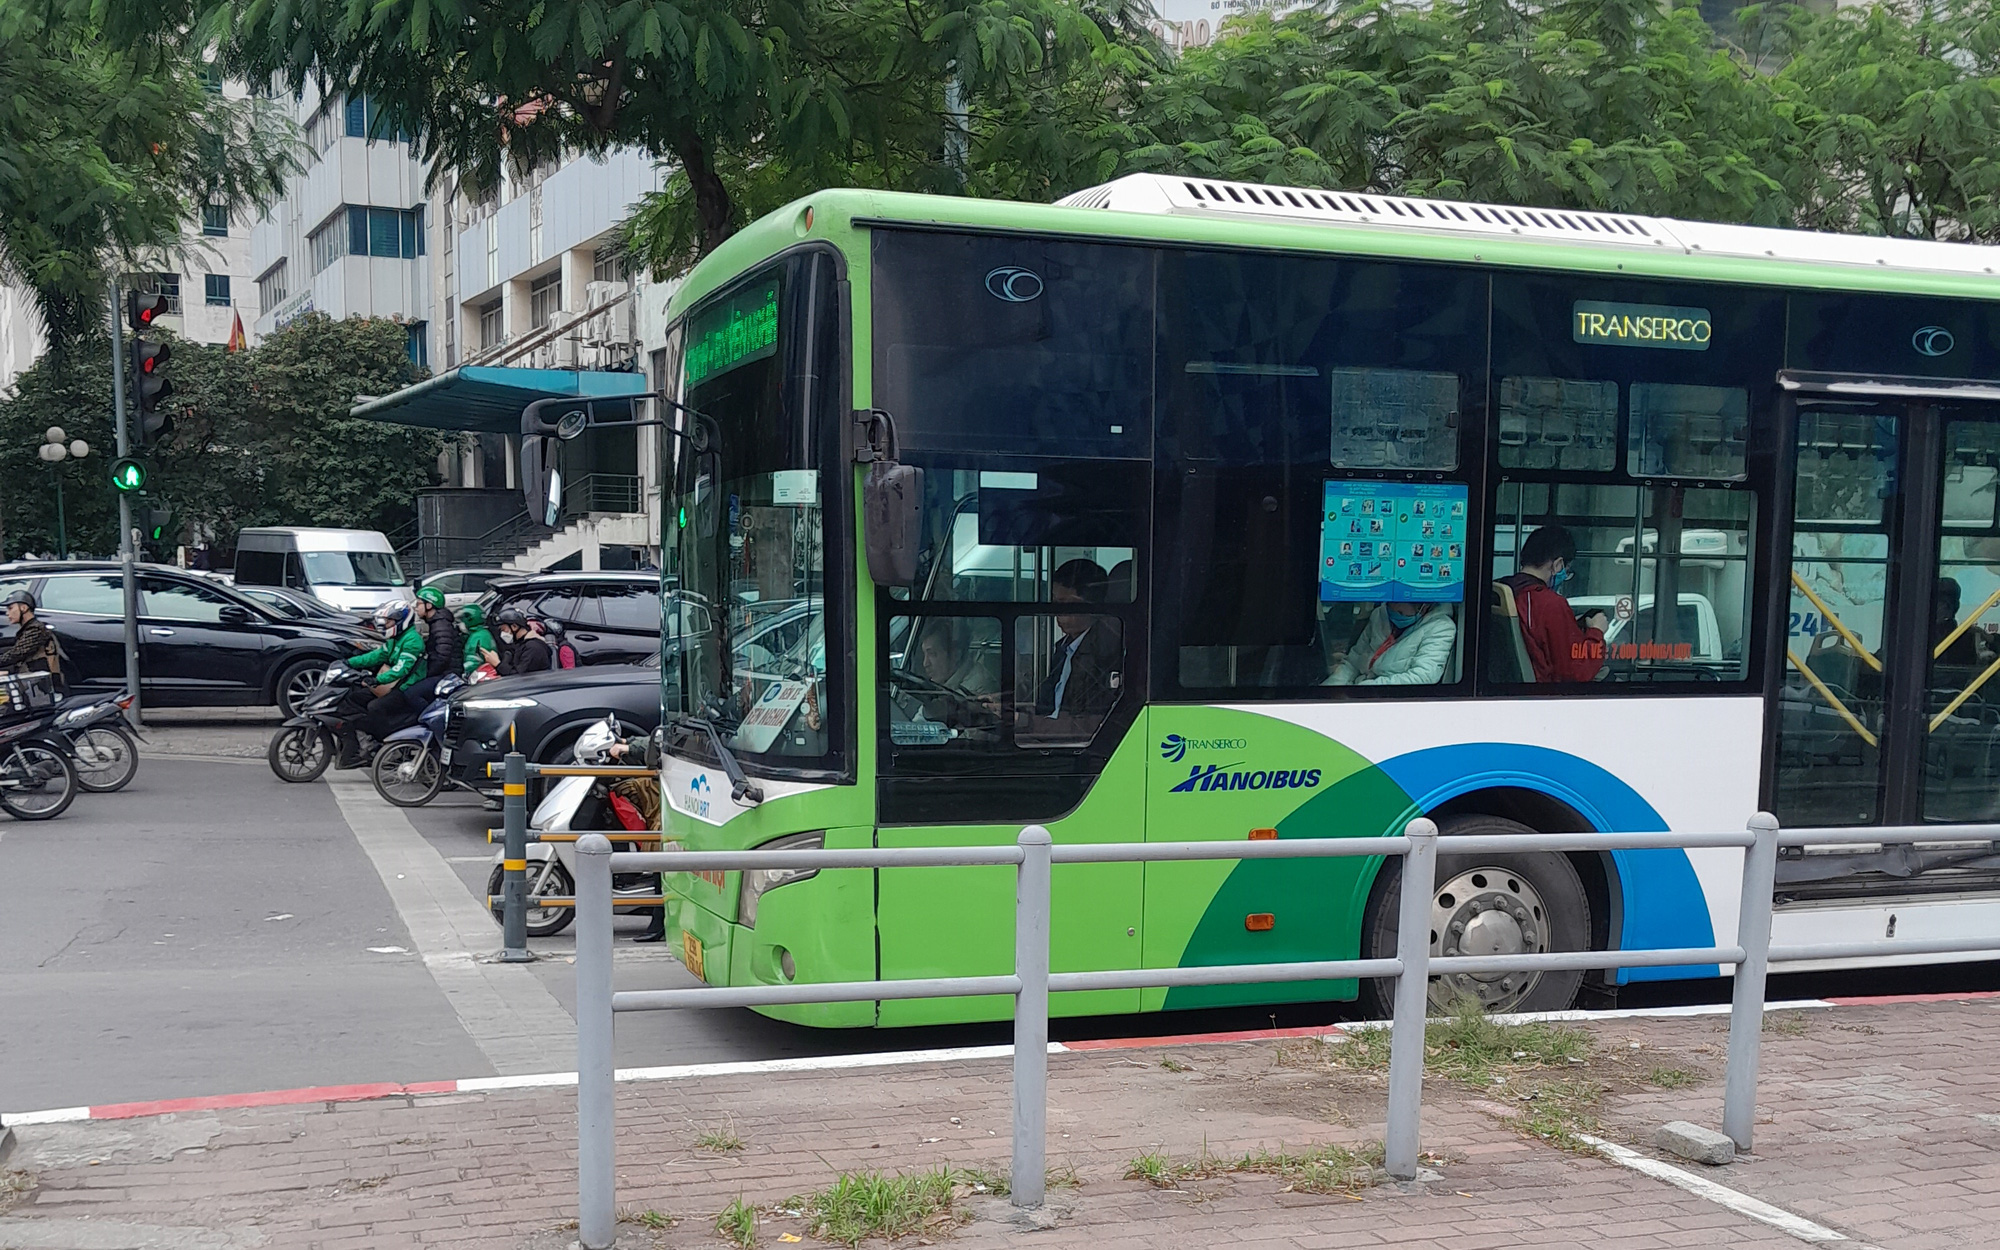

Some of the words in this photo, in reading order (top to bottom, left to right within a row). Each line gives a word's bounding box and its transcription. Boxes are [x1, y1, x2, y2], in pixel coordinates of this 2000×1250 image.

[1576, 312, 1712, 343] TRANSERCO
[1571, 640, 1588, 659] GIÁ
[1187, 738, 1247, 750] TRANSERCO
[1168, 763, 1322, 793] HANOIBUS
